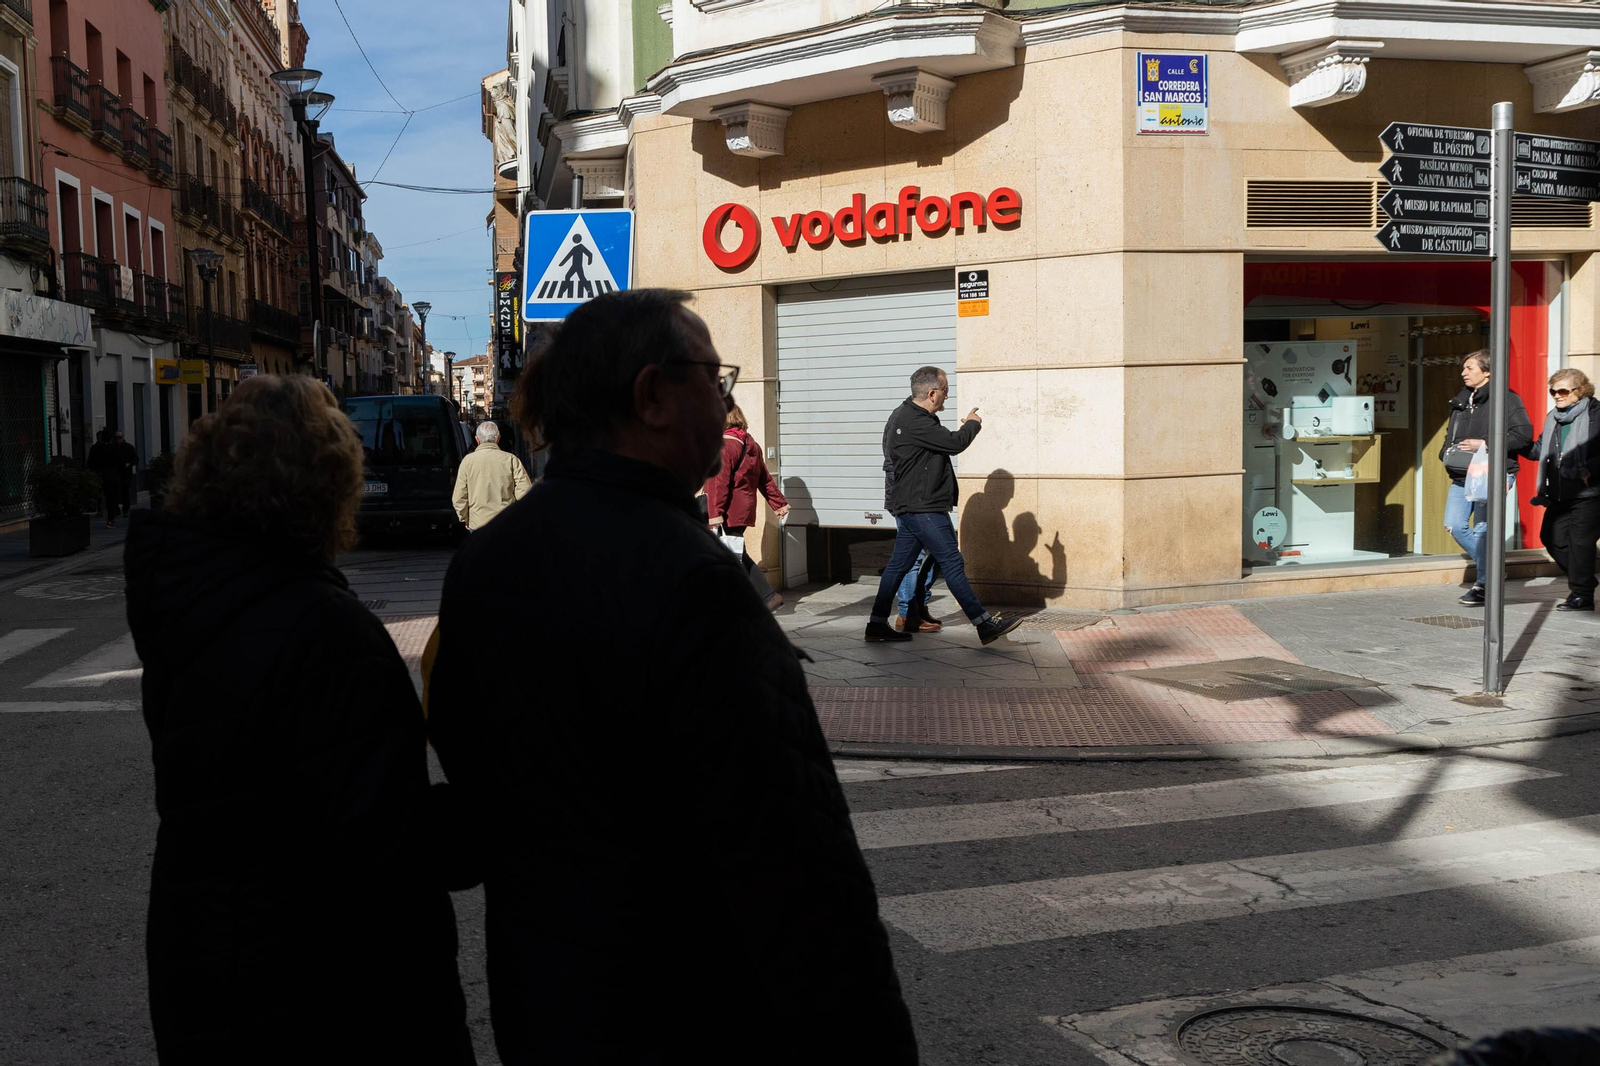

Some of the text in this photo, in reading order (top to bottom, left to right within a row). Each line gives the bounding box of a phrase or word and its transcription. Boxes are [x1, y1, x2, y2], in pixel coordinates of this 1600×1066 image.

[1158, 80, 1200, 91] CORREDERA
[1144, 92, 1201, 102] SAN MARCOS
[1160, 114, 1204, 126] antonio
[1408, 126, 1474, 141] OFICINA DE TURISMO
[1433, 140, 1474, 156] EL PÓSITO
[1420, 158, 1473, 173] BASÍLICA MENOR
[1532, 150, 1595, 167] PAISAJE MINERO
[1418, 173, 1473, 188] SANTA MARÍA
[1532, 169, 1557, 180] COSO DE
[1531, 182, 1597, 199] SANTA MARGARITA
[1404, 199, 1473, 213] MUSEO DE RAPHAEL
[771, 185, 1022, 248] vodafone
[1400, 224, 1472, 237] MUSEO ARQUEOLÓGICO
[1422, 236, 1473, 252] DE CÁSTULO
[500, 292, 510, 350] EMANUELE
[1351, 320, 1370, 330] Lowi
